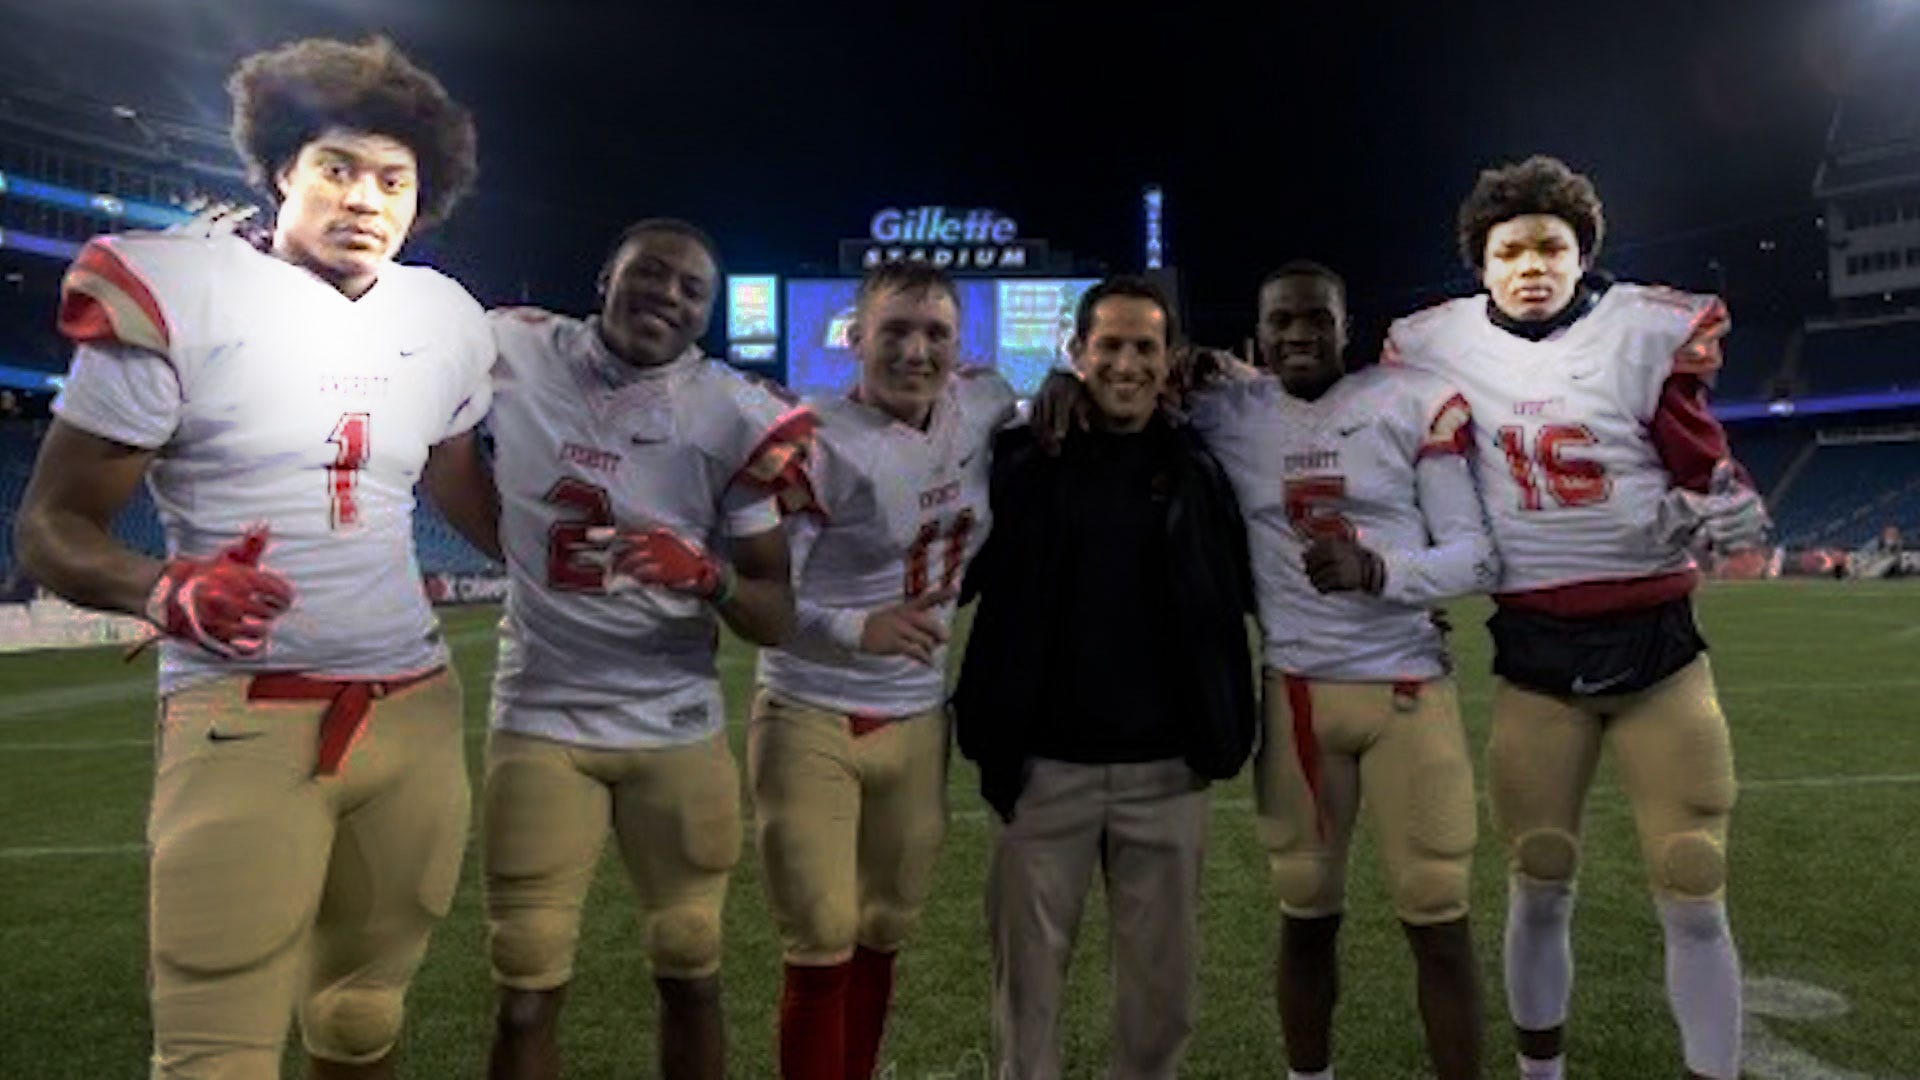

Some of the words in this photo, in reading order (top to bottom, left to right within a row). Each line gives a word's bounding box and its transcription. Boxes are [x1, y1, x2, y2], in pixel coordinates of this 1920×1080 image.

[863, 249, 1027, 268] STADIUM
[871, 206, 1018, 244] Gillette
[323, 411, 371, 533] 1
[1493, 423, 1614, 511] 16
[543, 476, 616, 596] 2
